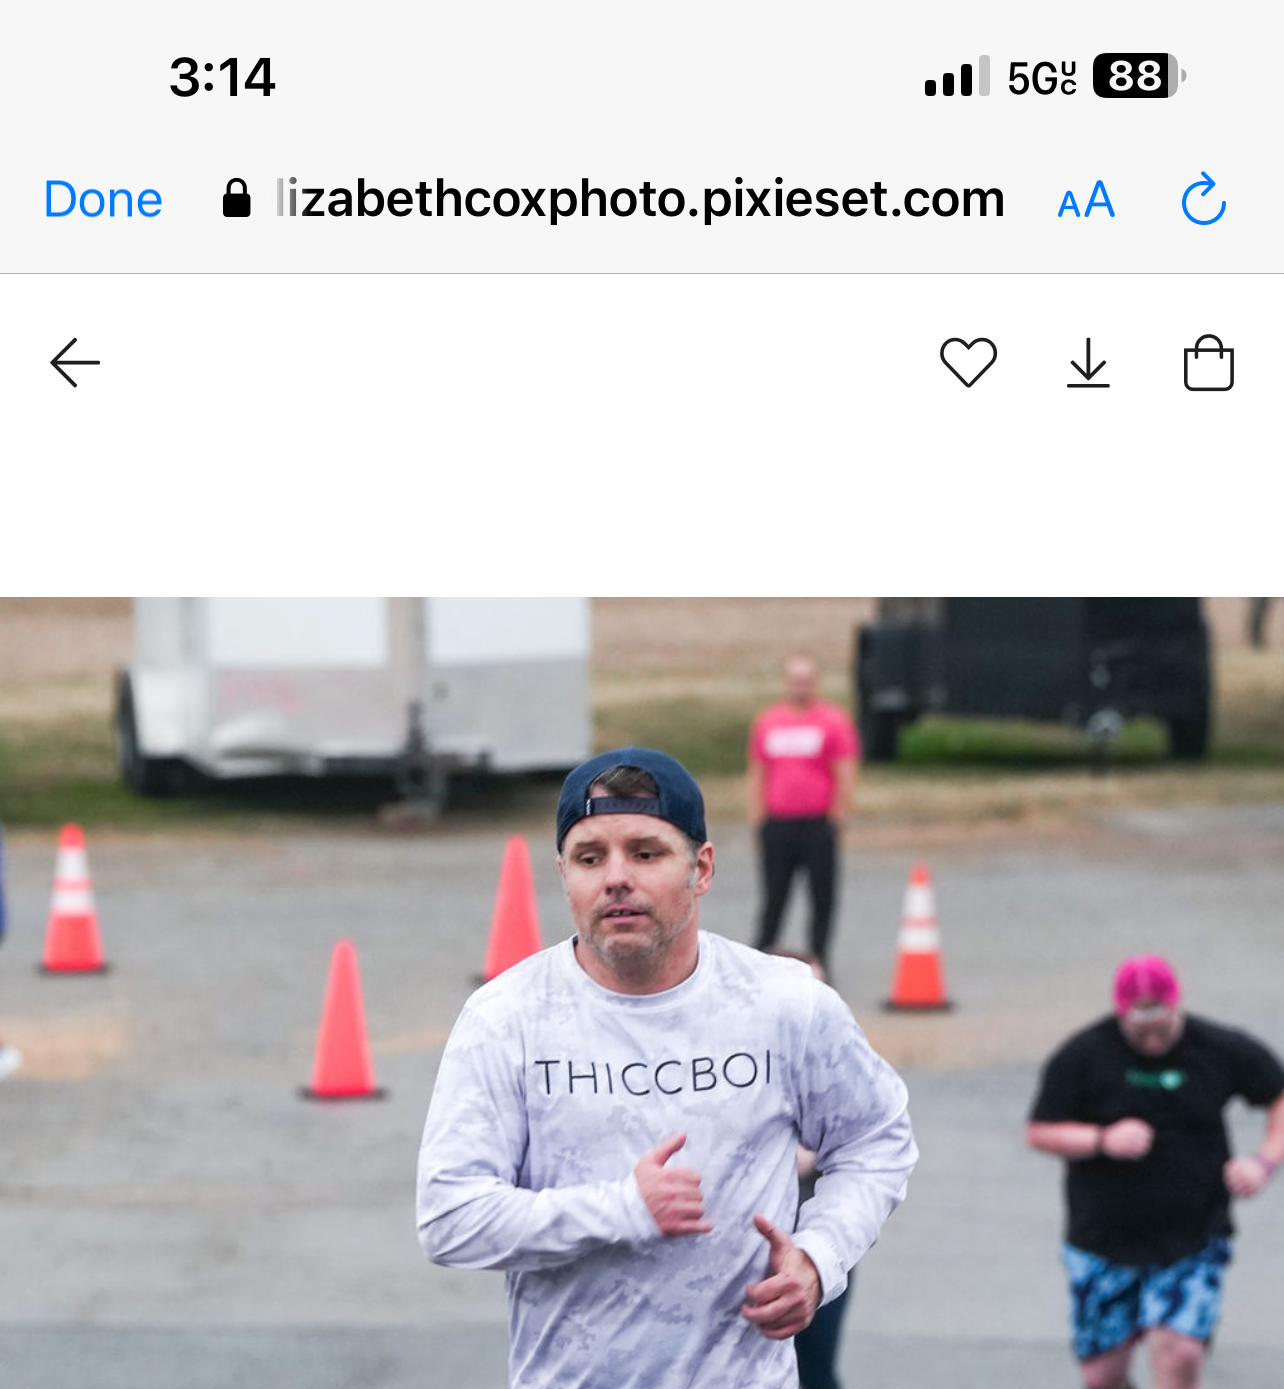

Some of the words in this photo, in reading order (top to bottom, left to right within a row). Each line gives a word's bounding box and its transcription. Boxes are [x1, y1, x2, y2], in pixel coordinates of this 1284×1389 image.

[169, 56, 276, 98] 3:14
[1108, 59, 1162, 92] 88
[45, 179, 163, 219] Done
[276, 176, 1004, 226] lizabethcoxphoto.pixieset.com
[534, 1049, 771, 1096] THICCBOI
